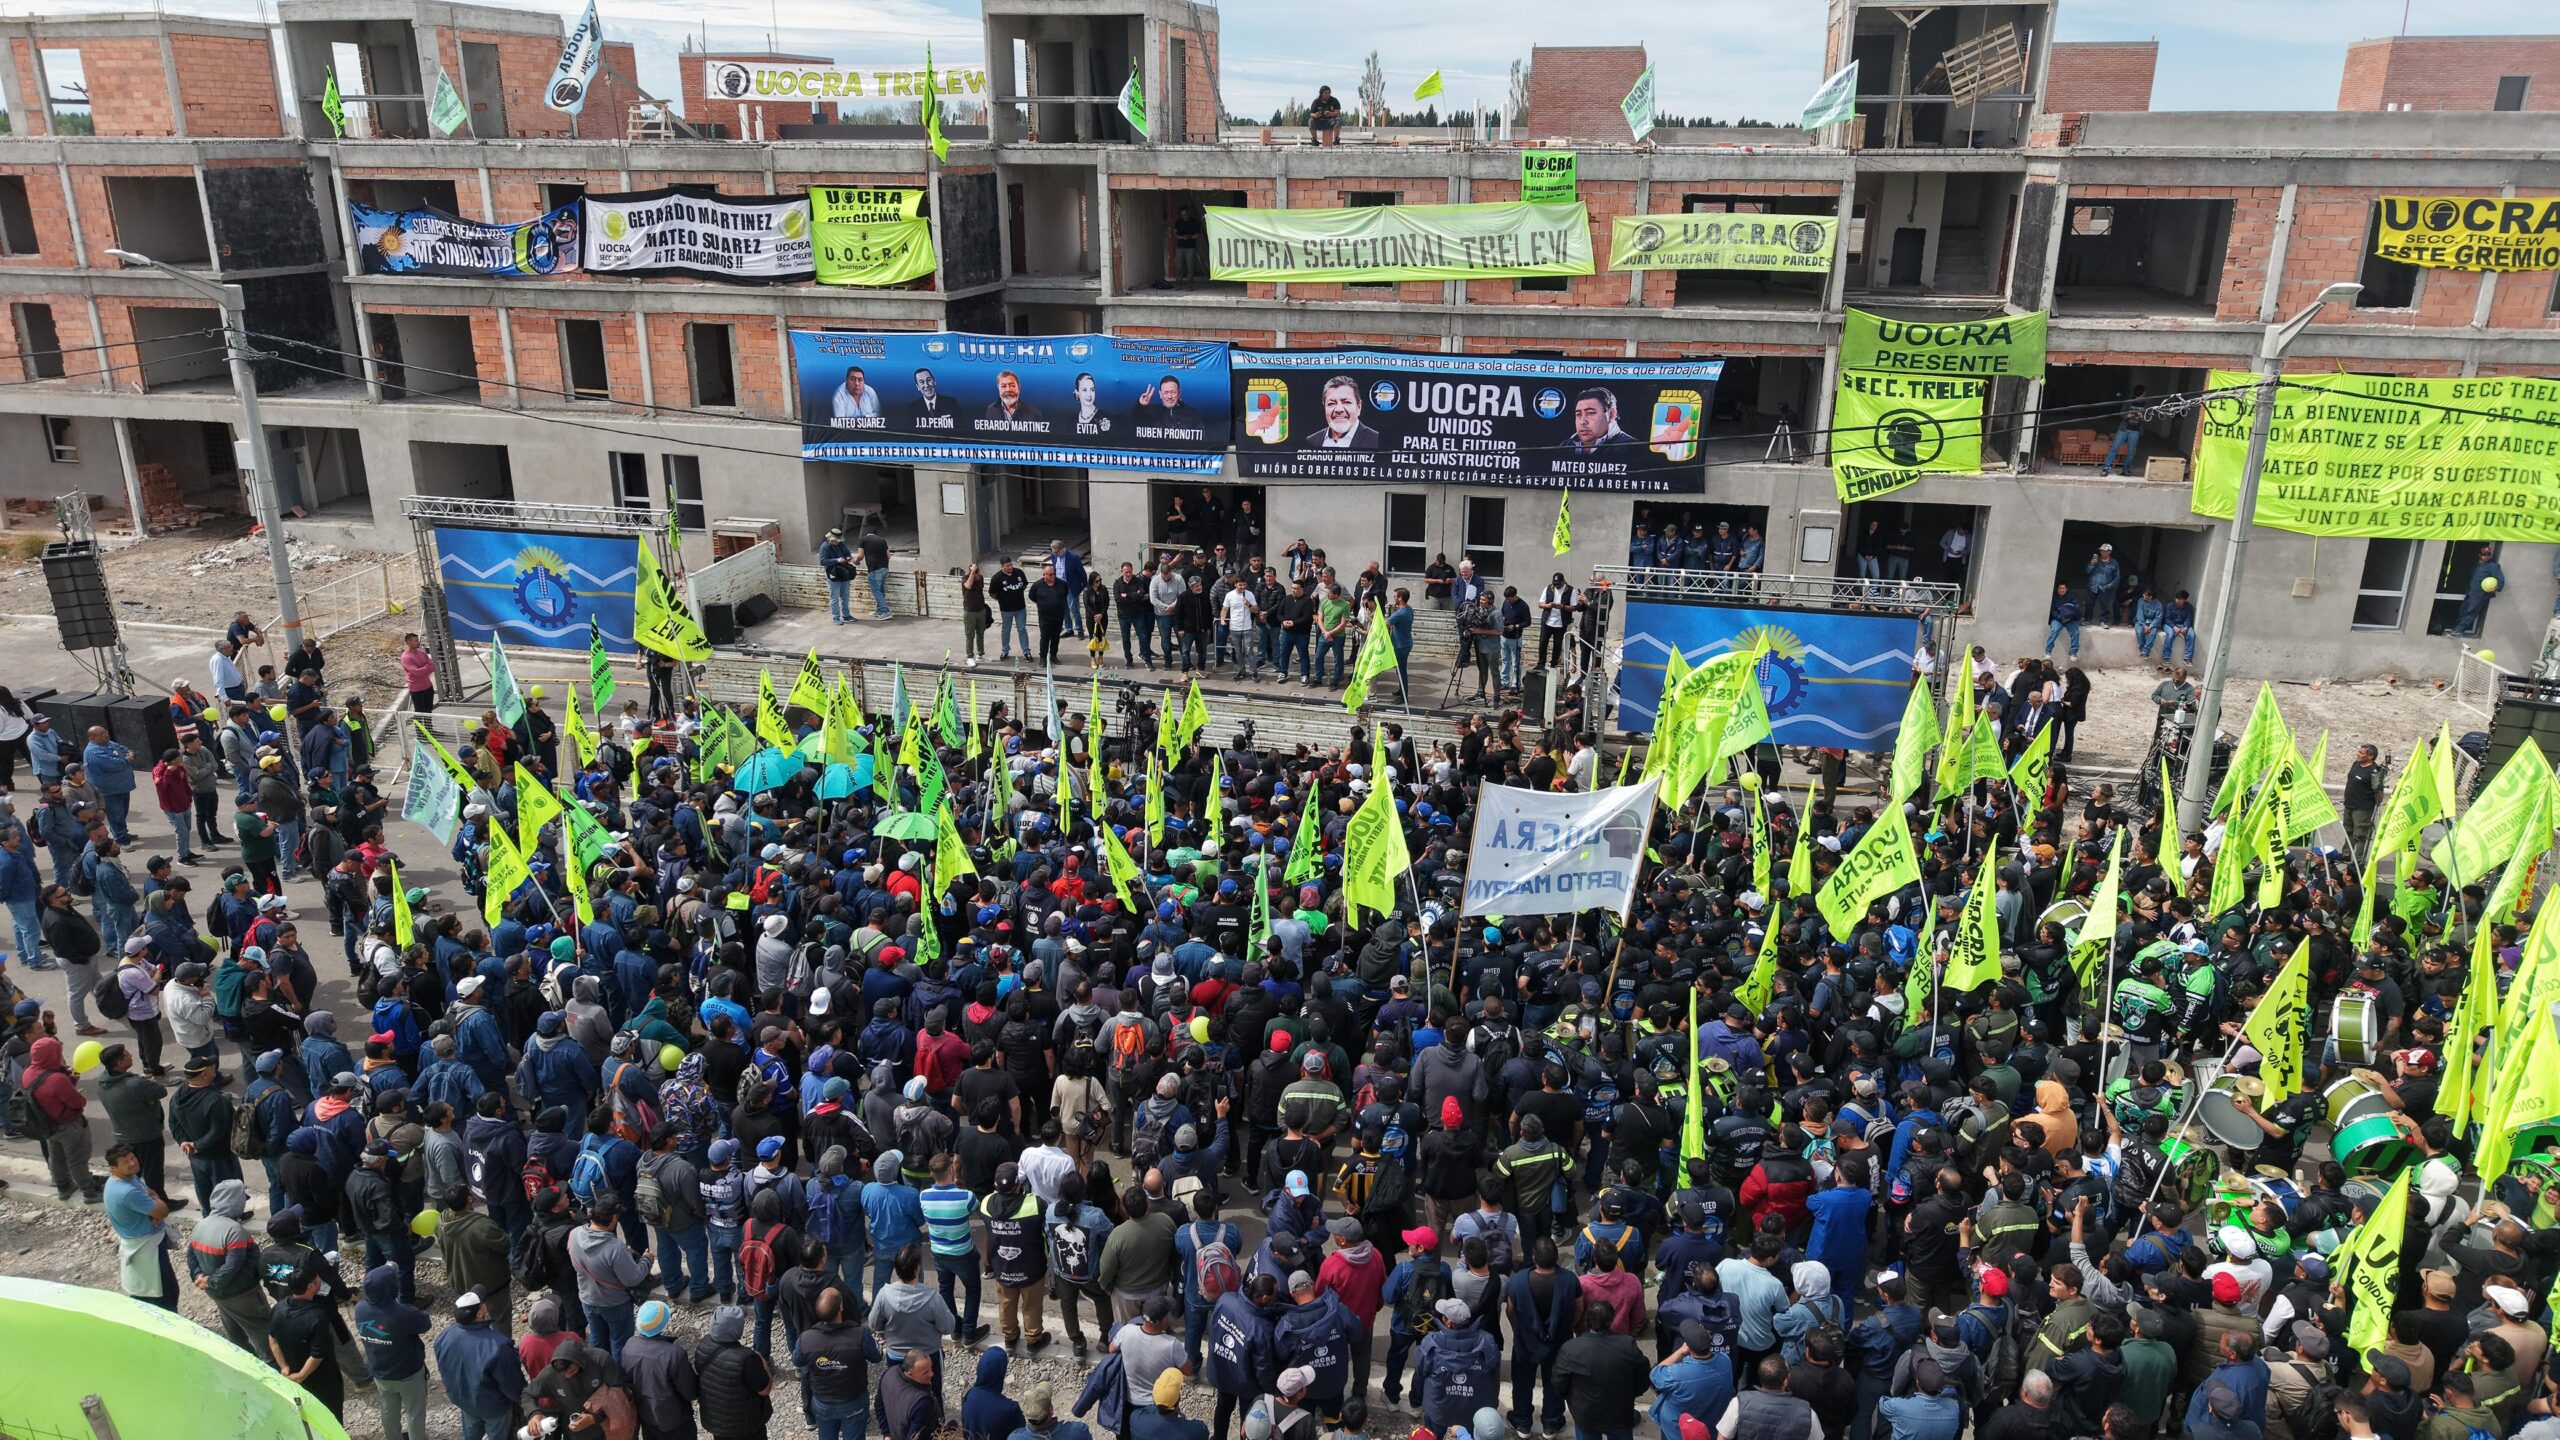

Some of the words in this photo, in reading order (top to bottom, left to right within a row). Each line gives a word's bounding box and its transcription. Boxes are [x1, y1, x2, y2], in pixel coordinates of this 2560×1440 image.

[756, 70, 863, 96] UOCRA
[874, 70, 987, 96] TRELEW
[412, 217, 453, 236] SIEMPRE
[628, 203, 696, 229] GERARDO
[697, 206, 773, 231] MARTINEZ
[599, 243, 632, 253] UOCRA
[643, 229, 698, 249] MATEO
[702, 232, 763, 254] SUAREZ
[775, 240, 812, 252] UOCRA
[2405, 234, 2459, 244] SECC.
[2466, 234, 2546, 247] TRELEW
[412, 239, 433, 265] MI
[434, 242, 514, 268] SINDICATO
[664, 248, 676, 262] TE
[678, 248, 734, 269] BANCAMOS
[1218, 237, 1296, 269] UOCRA
[1302, 234, 1453, 269] SECCIONAL
[1734, 254, 1778, 266] CLAUDIO
[1782, 255, 1834, 267] PAREDES
[2382, 244, 2446, 263] ESTE
[2454, 245, 2560, 268] GREMIO
[1878, 320, 2013, 347] UOCRA
[958, 334, 1056, 364] UOCRA
[1121, 353, 1143, 363] nace
[1144, 355, 1157, 363] un
[1260, 355, 1293, 365] existe
[1295, 356, 1321, 367] para
[1323, 354, 1334, 365] el
[1337, 354, 1398, 366] Peronismo
[1400, 357, 1425, 368] más
[1428, 359, 1450, 371] que
[1453, 361, 1475, 370] una
[1478, 361, 1503, 372] sola
[1505, 361, 1537, 373] clase
[1540, 362, 1554, 373] de
[1558, 363, 1607, 376] hombre,
[1611, 364, 1628, 375] los
[1630, 366, 1655, 378] que
[1874, 349, 2009, 373] PRESENTE
[1843, 373, 1905, 398] SECC.
[2366, 381, 2430, 398] UOCRA
[2452, 382, 2504, 399] SECC
[1407, 380, 1524, 418] UOCRA
[830, 417, 856, 429] MATEO
[857, 417, 886, 429] SUAREZ
[2273, 404, 2294, 420] LA
[2306, 404, 2421, 425] BIENVENIDA
[2439, 409, 2465, 425] AL
[2486, 407, 2523, 424] SEC
[974, 420, 1010, 432] GERARDO
[1011, 420, 1050, 433] MARTINEZ
[1076, 423, 1099, 435] EVITA
[1136, 426, 1163, 439] RUBEN
[1163, 427, 1203, 441] PRONOTTI
[1428, 416, 1493, 437] UNIDOS
[1403, 435, 1438, 450] PARA
[1442, 438, 1458, 451] EL
[1462, 439, 1517, 454] FUTURO
[2203, 421, 2280, 442] GERAO
[2283, 428, 2378, 449] MARTINEZ
[2384, 435, 2408, 450] SE
[2419, 435, 2444, 450] LE
[2458, 436, 2559, 456] AGRADECE
[813, 446, 848, 459] UNIÓN
[852, 446, 865, 457] DE
[868, 446, 920, 459] OBREROS
[923, 447, 937, 459] DE
[940, 447, 954, 459] LA
[957, 447, 1044, 463] CONSTRUCCIÓN
[1047, 450, 1061, 463] DE
[1064, 451, 1079, 464] LA
[1081, 451, 1145, 467] REPUBLICA
[1148, 456, 1214, 470] ARGENTINA
[1391, 449, 1417, 464] DEL
[1419, 451, 1521, 470] CONSTRUCTOR
[1551, 460, 1586, 474] MATEO
[1587, 461, 1628, 476] SUAREZ
[1254, 462, 1288, 475] UNIÓN
[1291, 464, 1304, 475] DE
[1308, 465, 1359, 476] OBREROS
[1362, 466, 1376, 477] DE
[1379, 467, 1392, 478] LA
[1396, 468, 1487, 484] CONSTRUCCIÓN
[1490, 472, 1504, 484] DE
[1508, 473, 1522, 486] LA
[1525, 475, 1594, 489] REPUBLICA
[1598, 478, 1670, 491] ARGENTINA
[2325, 462, 2383, 479] SUREZ
[2388, 465, 2424, 481] POR
[2277, 483, 2380, 504] VILLAFAÑE
[2391, 491, 2443, 507] JUAN
[2450, 490, 2528, 508] CARLOS
[2294, 508, 2360, 526] JUNTO
[2367, 511, 2390, 527] AL
[2400, 512, 2437, 528] SEC
[2442, 512, 2535, 528] ADJUNTO
[1618, 979, 1636, 987] MATEO
